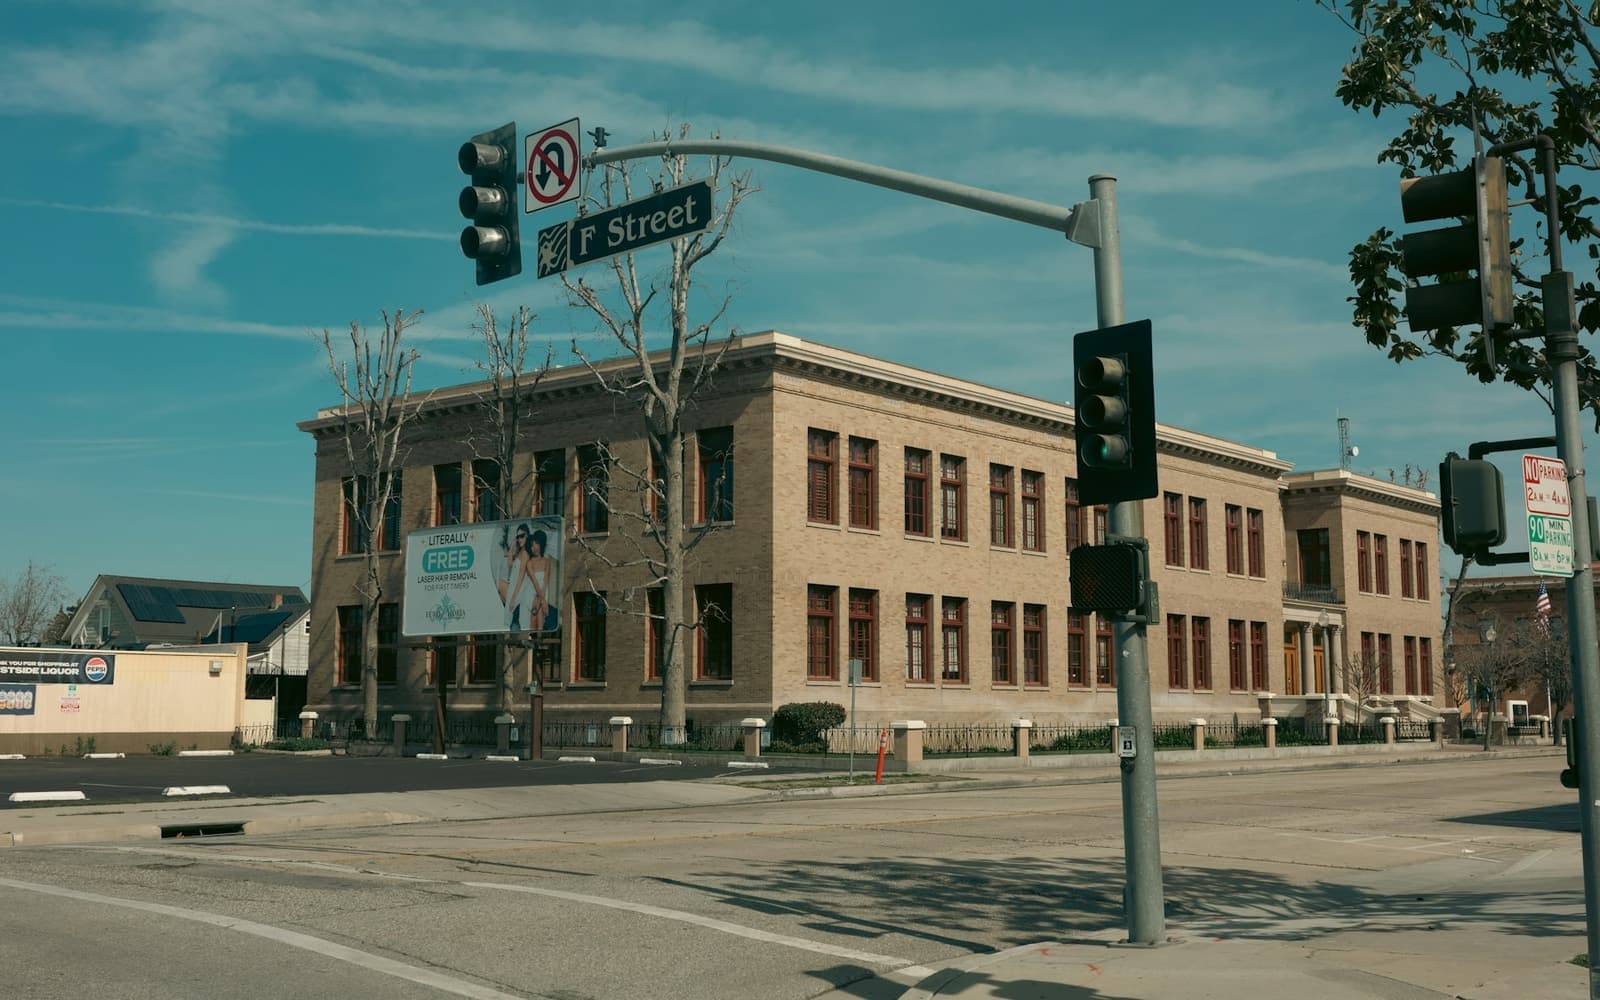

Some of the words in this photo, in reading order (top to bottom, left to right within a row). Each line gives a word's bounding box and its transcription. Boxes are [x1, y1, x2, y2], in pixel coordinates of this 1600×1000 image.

[579, 224, 596, 256] F
[607, 194, 698, 248] Street
[1525, 457, 1538, 480] NO
[1539, 464, 1567, 482] PARKING
[1530, 516, 1543, 539] 90
[428, 532, 469, 546] LITERALLY
[1545, 530, 1570, 547] PARKING
[427, 549, 468, 570] FREE
[417, 575, 434, 584] LASER
[434, 573, 448, 582] HAIR
[449, 571, 477, 581] REMOVAL
[40, 667, 79, 675] LIQUOR
